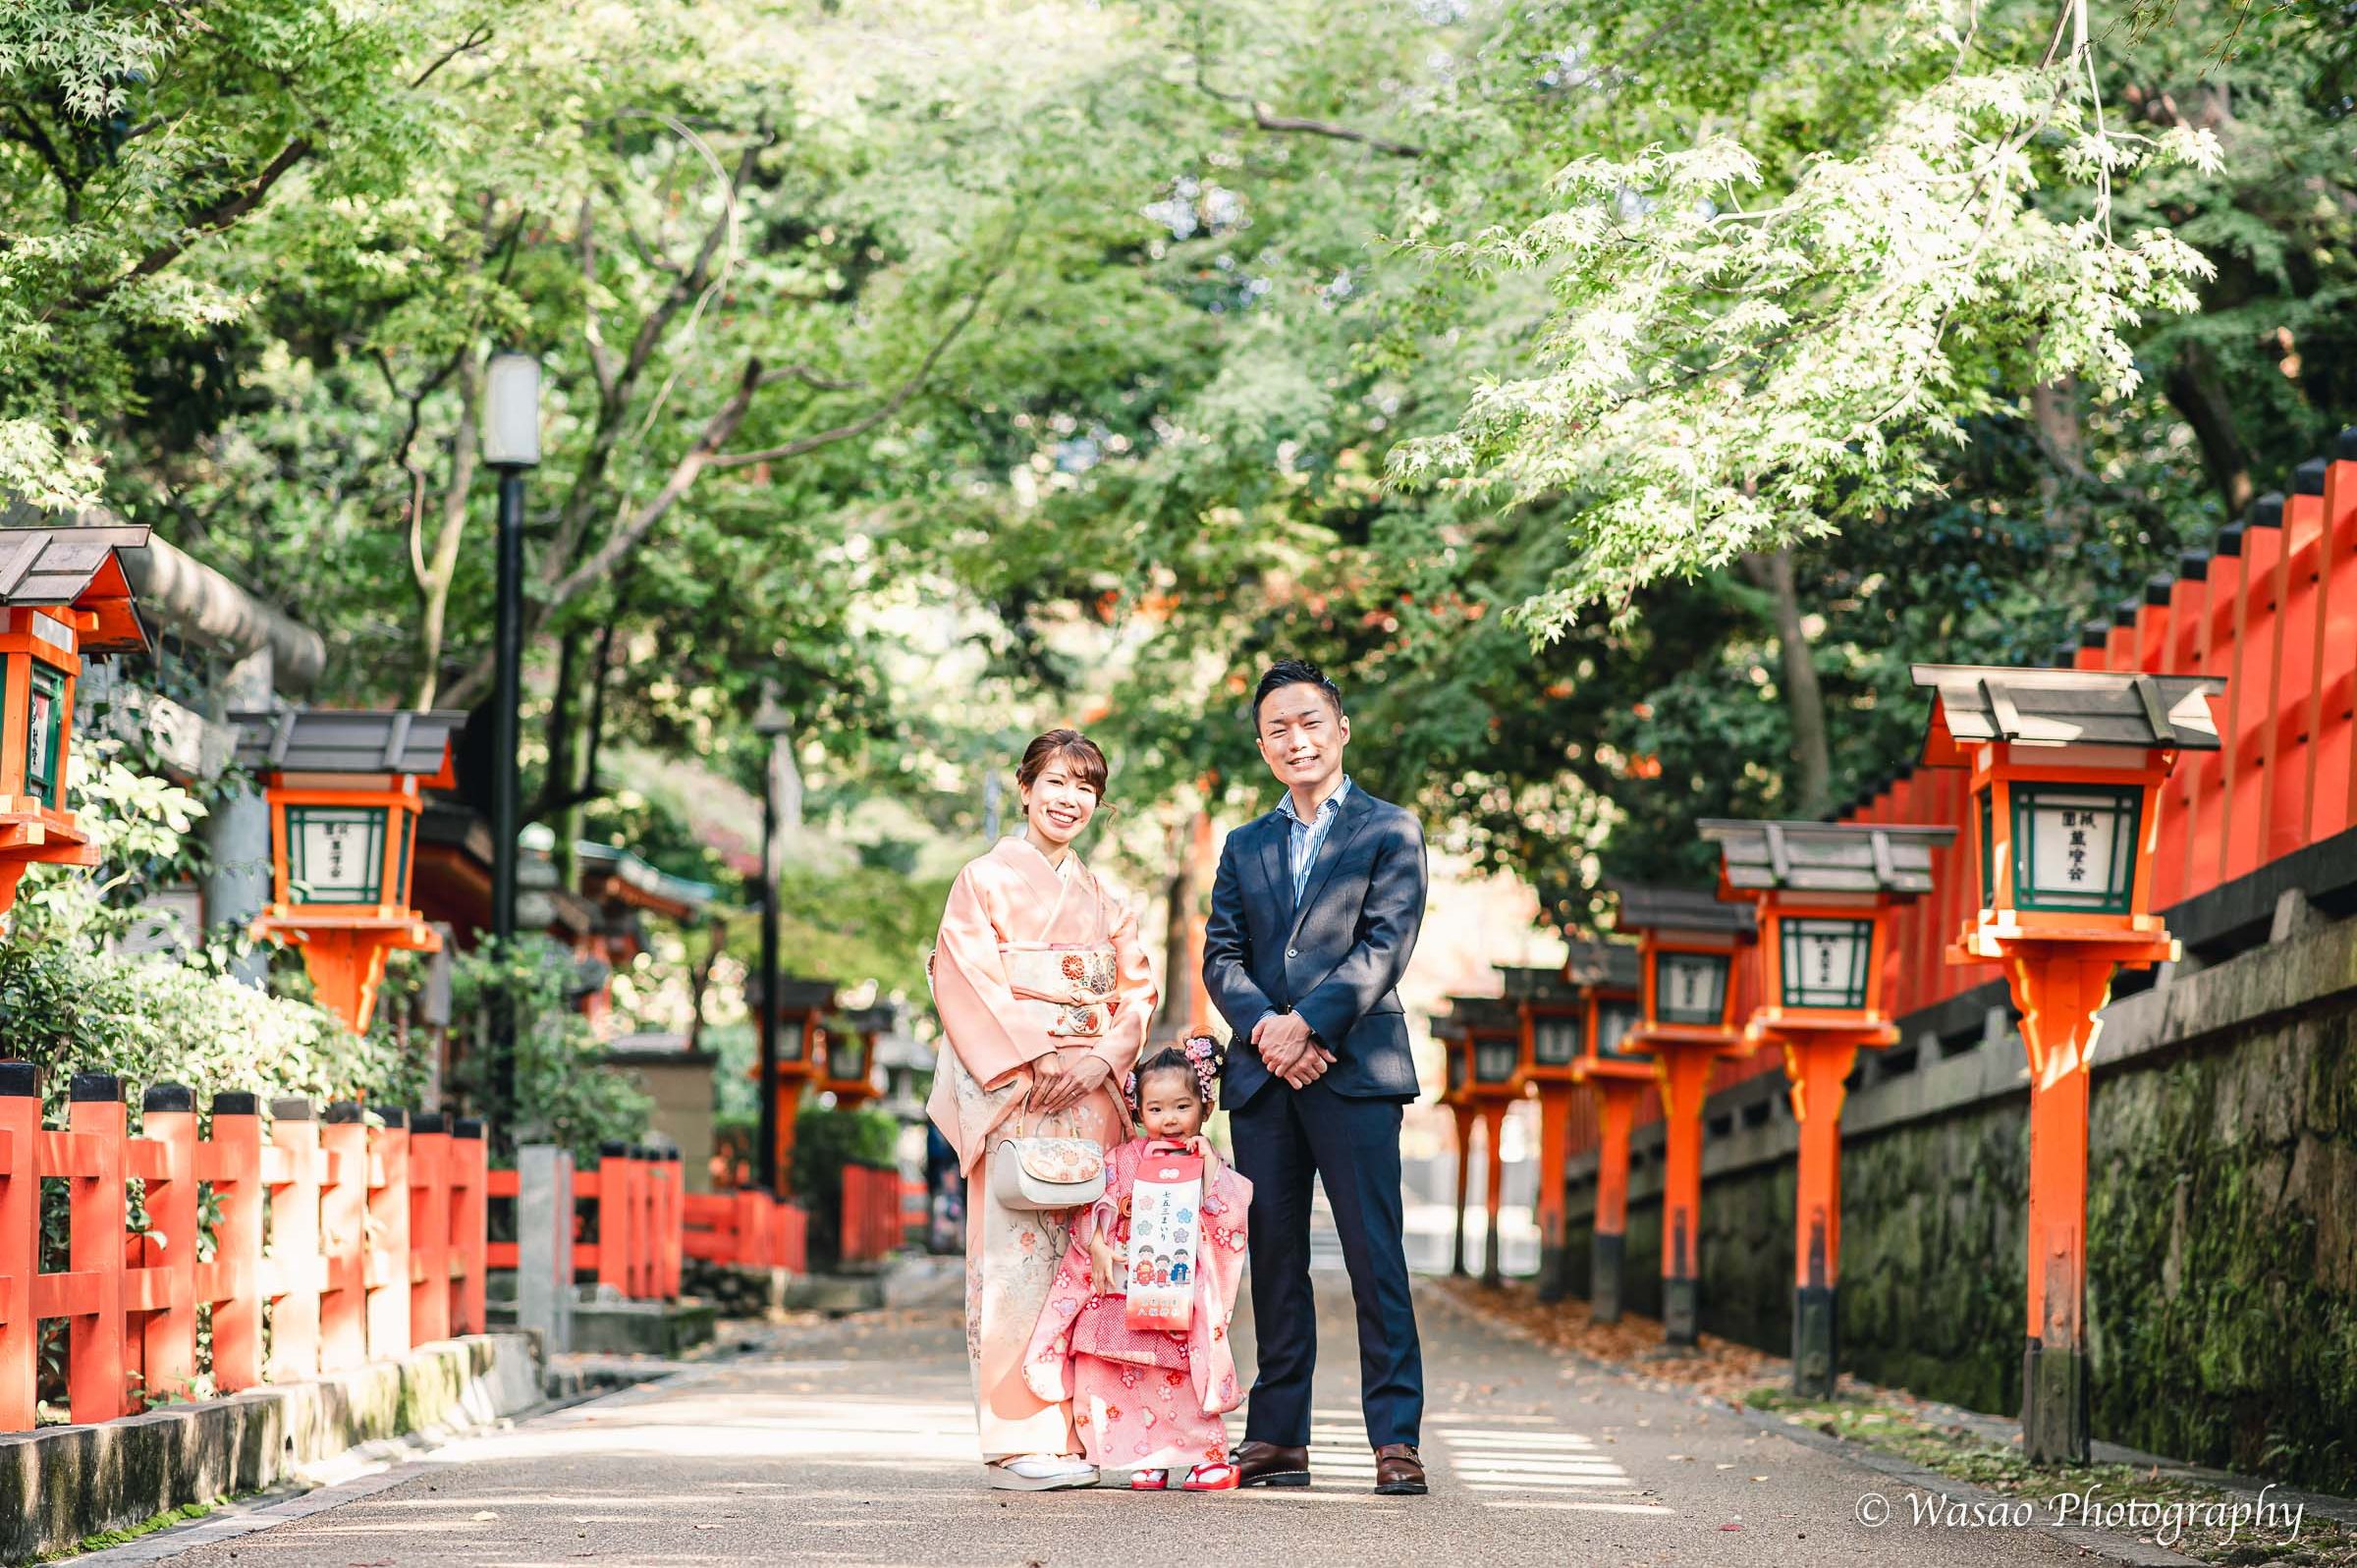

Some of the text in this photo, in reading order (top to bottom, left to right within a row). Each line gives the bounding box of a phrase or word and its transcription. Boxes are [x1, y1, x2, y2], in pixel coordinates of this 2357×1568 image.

[1160, 1190, 1172, 1242] 七五三まいり
